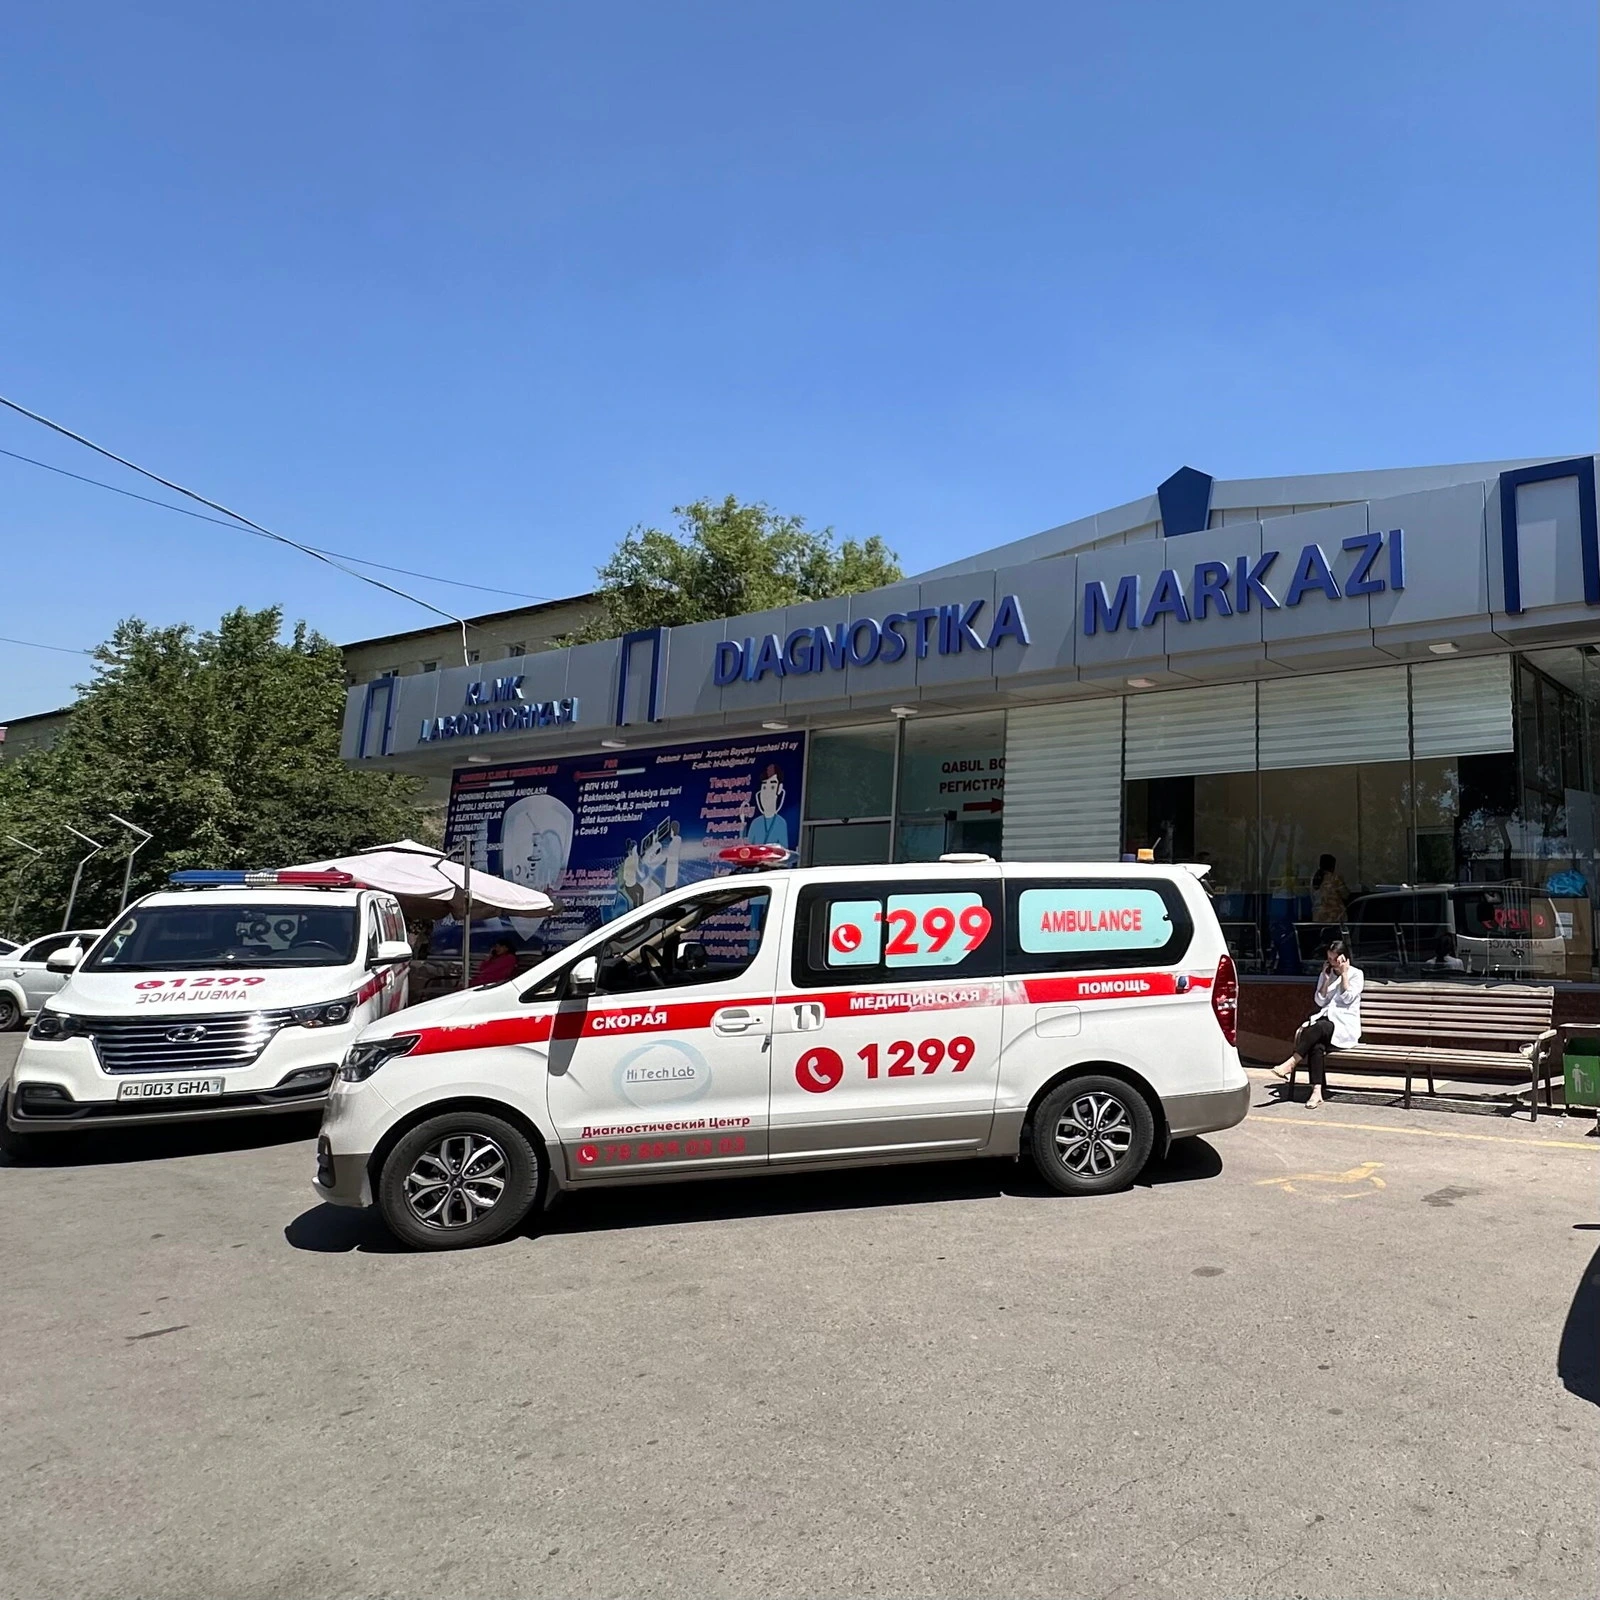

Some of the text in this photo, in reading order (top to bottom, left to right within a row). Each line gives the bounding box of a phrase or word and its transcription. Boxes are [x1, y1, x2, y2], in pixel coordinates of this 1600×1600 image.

[713, 528, 1406, 686] DIAGNOSTIKA MARKAZI
[942, 760, 985, 773] QABUL
[939, 778, 1005, 794] РЕГИСТРА
[580, 826, 608, 836] Covid-19
[1040, 908, 1142, 933] AMBULANCE
[167, 977, 265, 988] 1299
[591, 979, 1151, 1030] СКОРАЯ МЕДИЦИНСКАЯ ПОМОЩЬ
[857, 1036, 976, 1079] 1299
[626, 1066, 696, 1080] Hi Tech Lab
[125, 1081, 210, 1096] 01 003 GHA
[581, 1117, 751, 1138] Диагностический Центр
